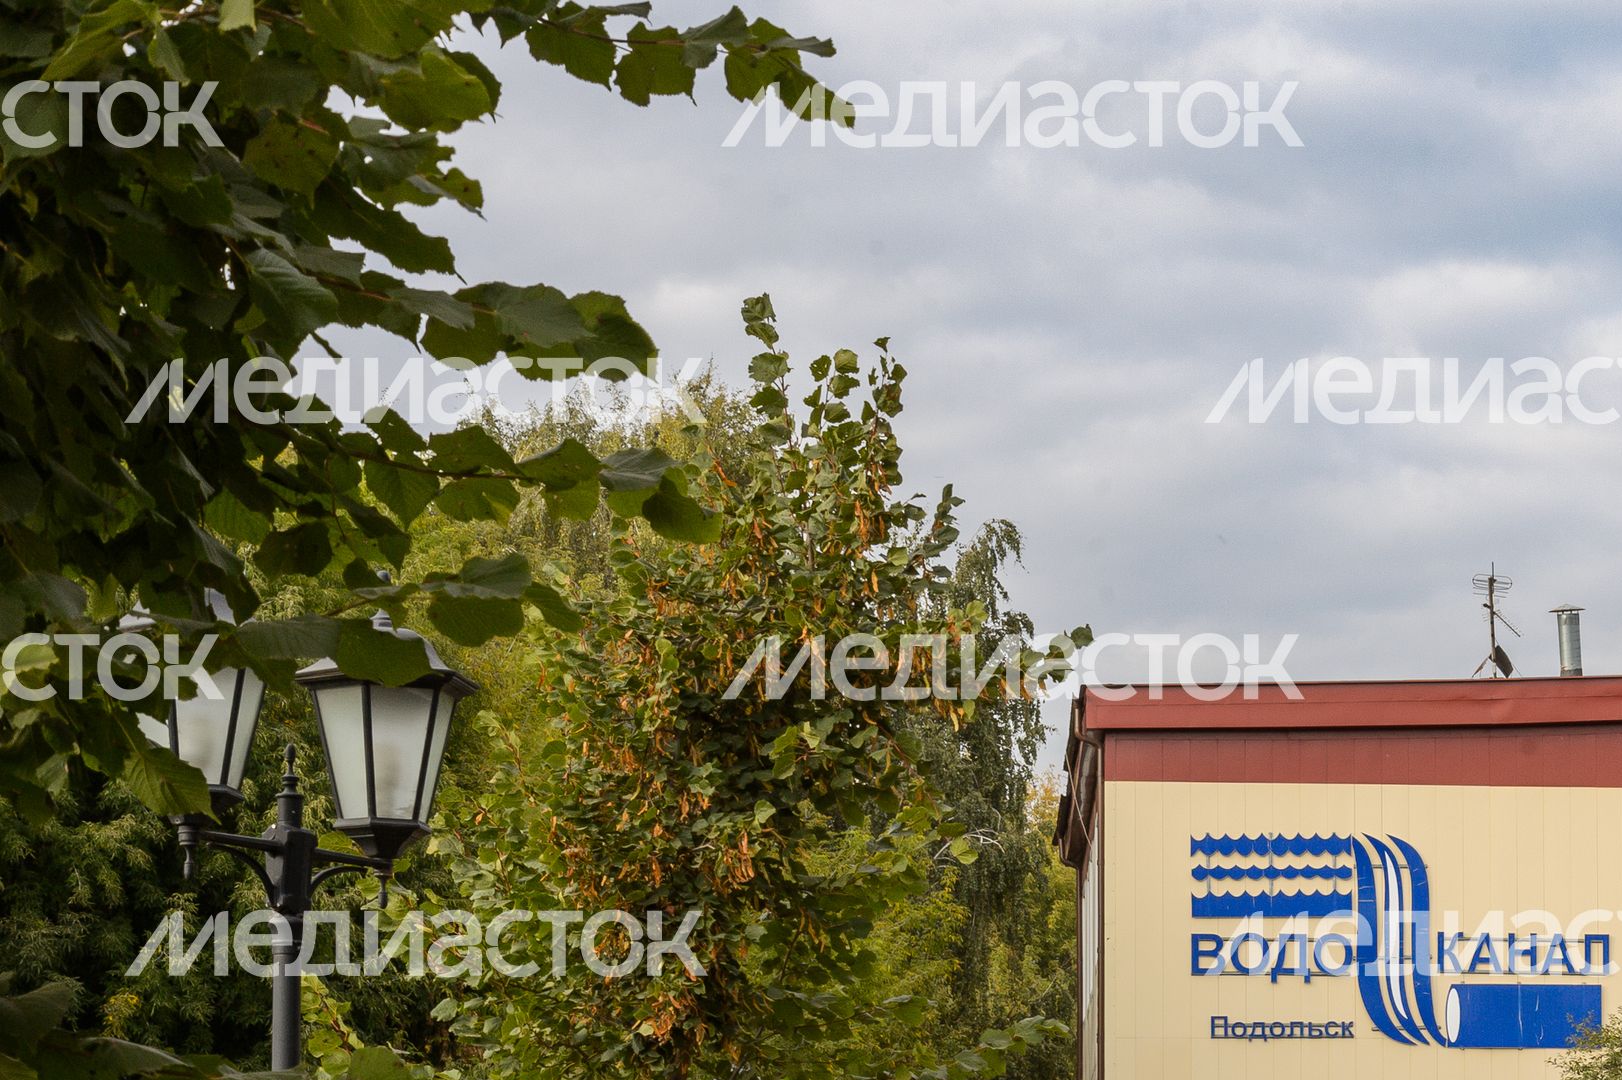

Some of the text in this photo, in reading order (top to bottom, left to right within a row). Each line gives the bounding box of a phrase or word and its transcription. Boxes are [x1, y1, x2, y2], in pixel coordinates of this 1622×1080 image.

[1191, 932, 1610, 983] ВОДО КАНАЛ
[1211, 1016, 1354, 1042] Подольск
